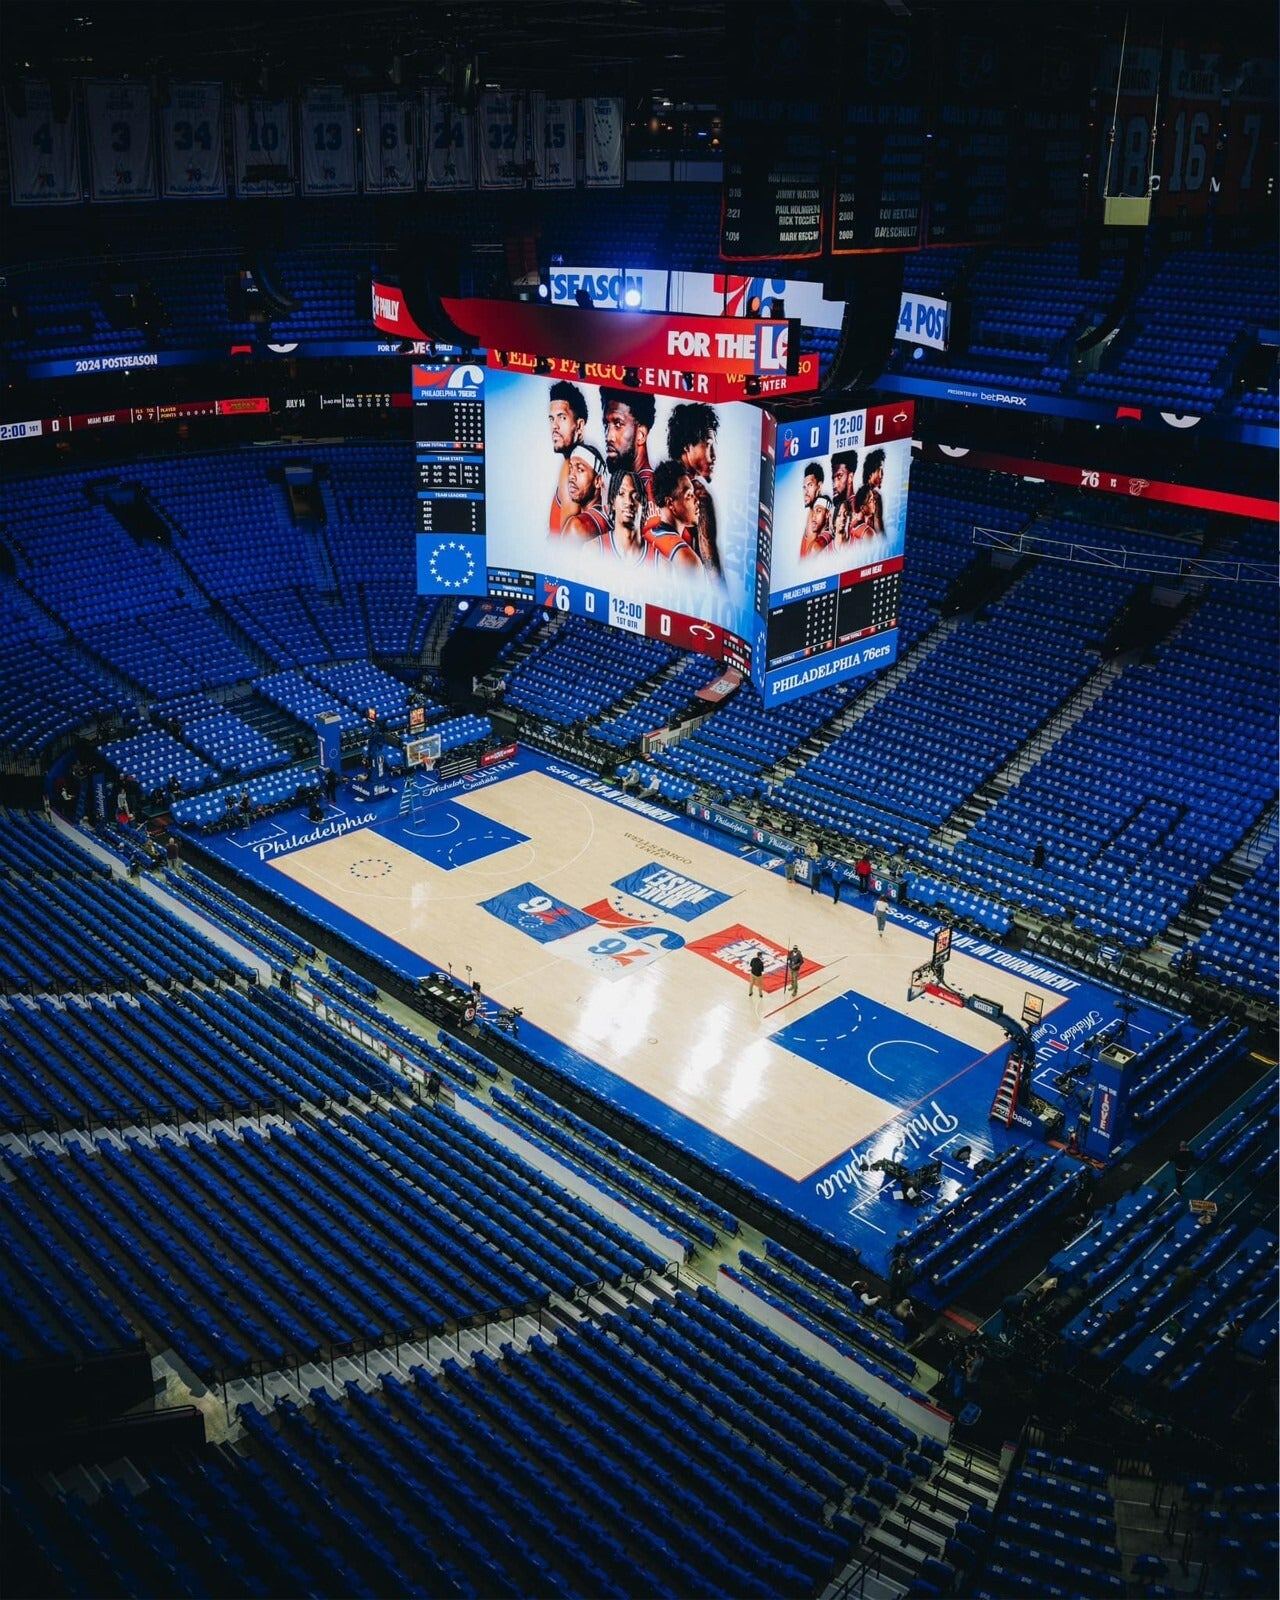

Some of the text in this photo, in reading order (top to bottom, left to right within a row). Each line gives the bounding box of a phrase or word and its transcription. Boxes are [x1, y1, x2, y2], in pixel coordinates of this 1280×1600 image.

[111, 122, 131, 152] 3
[173, 121, 212, 150] 34
[249, 122, 278, 151] 10
[313, 123, 342, 150] 13
[382, 123, 398, 149] 6
[1169, 111, 1209, 191] 16
[1240, 113, 1262, 189] 7
[779, 216, 794, 225] RICK
[780, 232, 797, 242] MARK
[550, 273, 643, 302] SEASON
[378, 344, 390, 352] FOR
[667, 331, 710, 358] FOR
[715, 333, 756, 360] THE
[76, 354, 158, 372] 2024 POSTSEASON
[458, 390, 477, 398] 76ERS
[637, 367, 709, 395] ENTR
[759, 379, 787, 392] ENTER
[286, 399, 306, 409] JULY 14
[947, 388, 970, 397] PRESENTED
[980, 391, 1027, 406] betPARX
[28, 425, 39, 433] 1ST
[52, 419, 60, 432] 0
[102, 415, 115, 423] HEAT
[784, 414, 884, 458] 76 0 12:00 0
[836, 435, 859, 449] 1ST QTR
[1081, 469, 1099, 487] 76
[783, 586, 811, 601] PHILADELPHIA
[543, 583, 671, 636] 76 0 12:00 0
[616, 616, 638, 630] 1ST QTR
[772, 645, 891, 695] PHILADELPHIA 76ers
[422, 760, 520, 796] Michelob ULTRA
[616, 794, 681, 822] TOURNAMENT
[253, 811, 376, 860] Philadelphia
[714, 814, 748, 835] Philadelphia
[632, 884, 687, 909] MAKE
[641, 869, 715, 904] NOISE!
[518, 896, 571, 925] 76
[587, 938, 650, 968] 76
[986, 946, 1081, 992] TOURNAMENT
[1060, 1010, 1103, 1044] Michelob
[1100, 1094, 1110, 1130] LOVE
